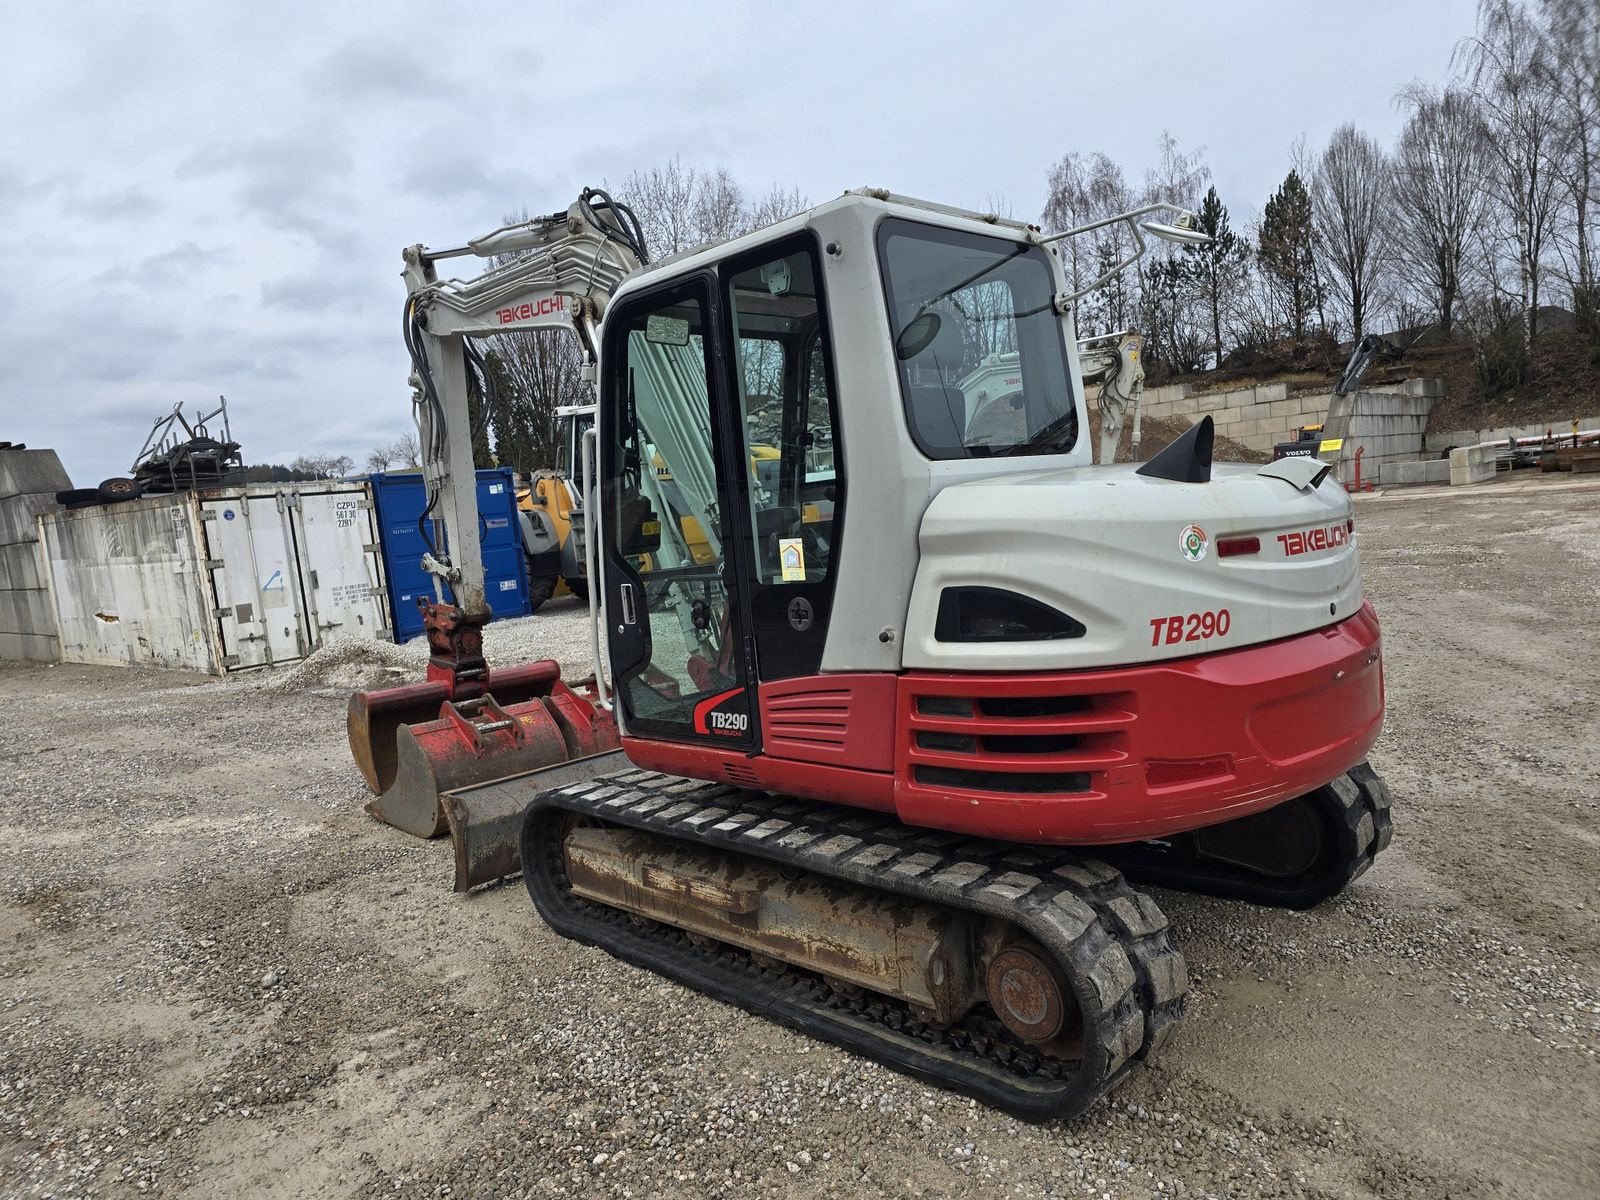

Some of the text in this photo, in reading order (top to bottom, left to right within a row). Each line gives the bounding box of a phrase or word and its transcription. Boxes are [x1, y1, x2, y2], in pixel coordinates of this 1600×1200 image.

[496, 296, 563, 324] TAKEUCHI
[336, 501, 356, 510] CZPU
[1150, 609, 1230, 647] TB290
[711, 712, 748, 730] TB290
